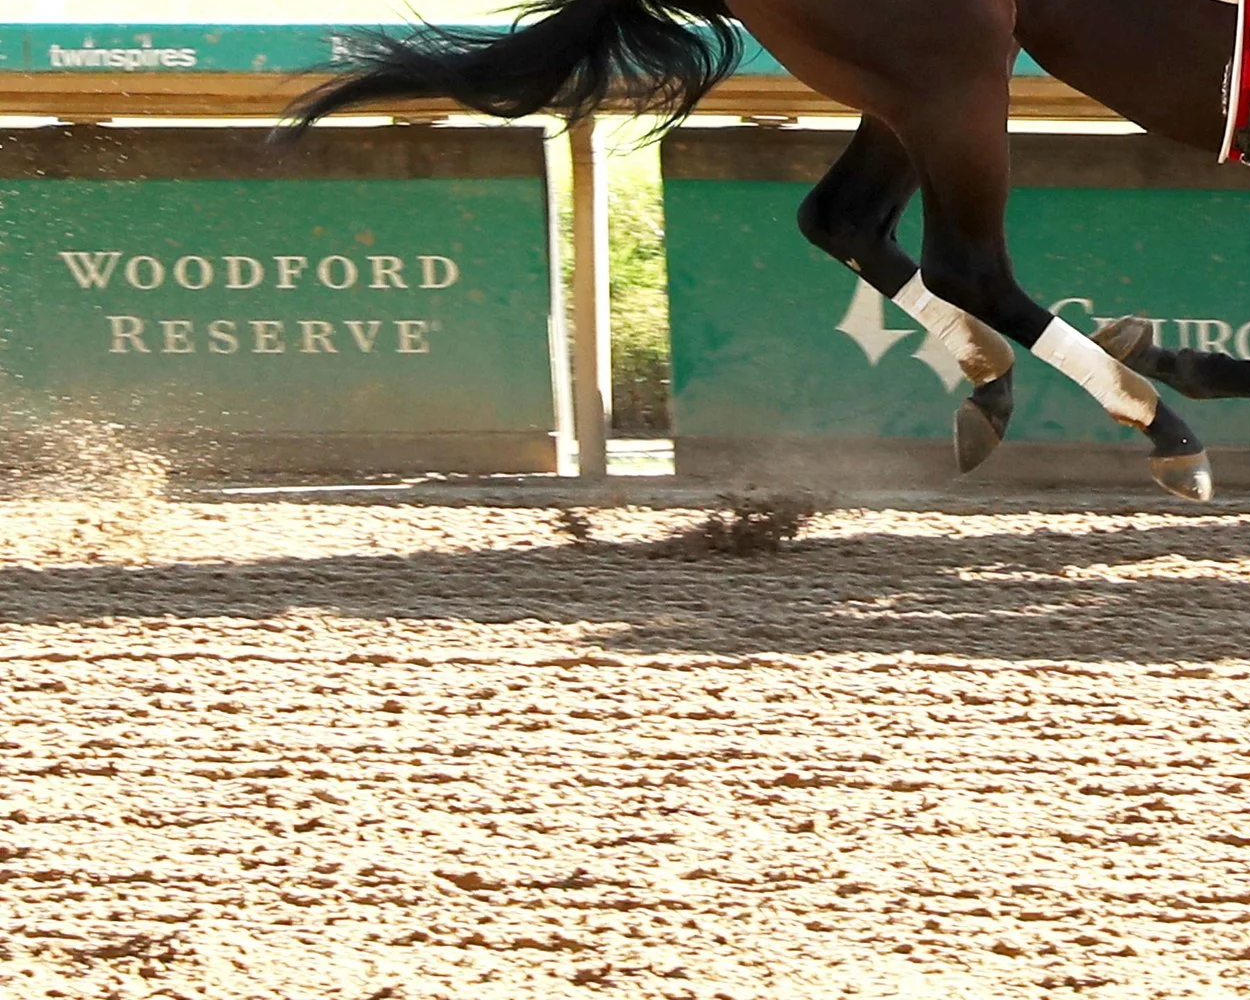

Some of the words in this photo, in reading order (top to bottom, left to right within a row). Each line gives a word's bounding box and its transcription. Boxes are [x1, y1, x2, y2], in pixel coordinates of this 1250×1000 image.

[50, 34, 197, 71] twinspires
[59, 250, 461, 290] WOODFORD
[106, 315, 431, 354] RESERVE
